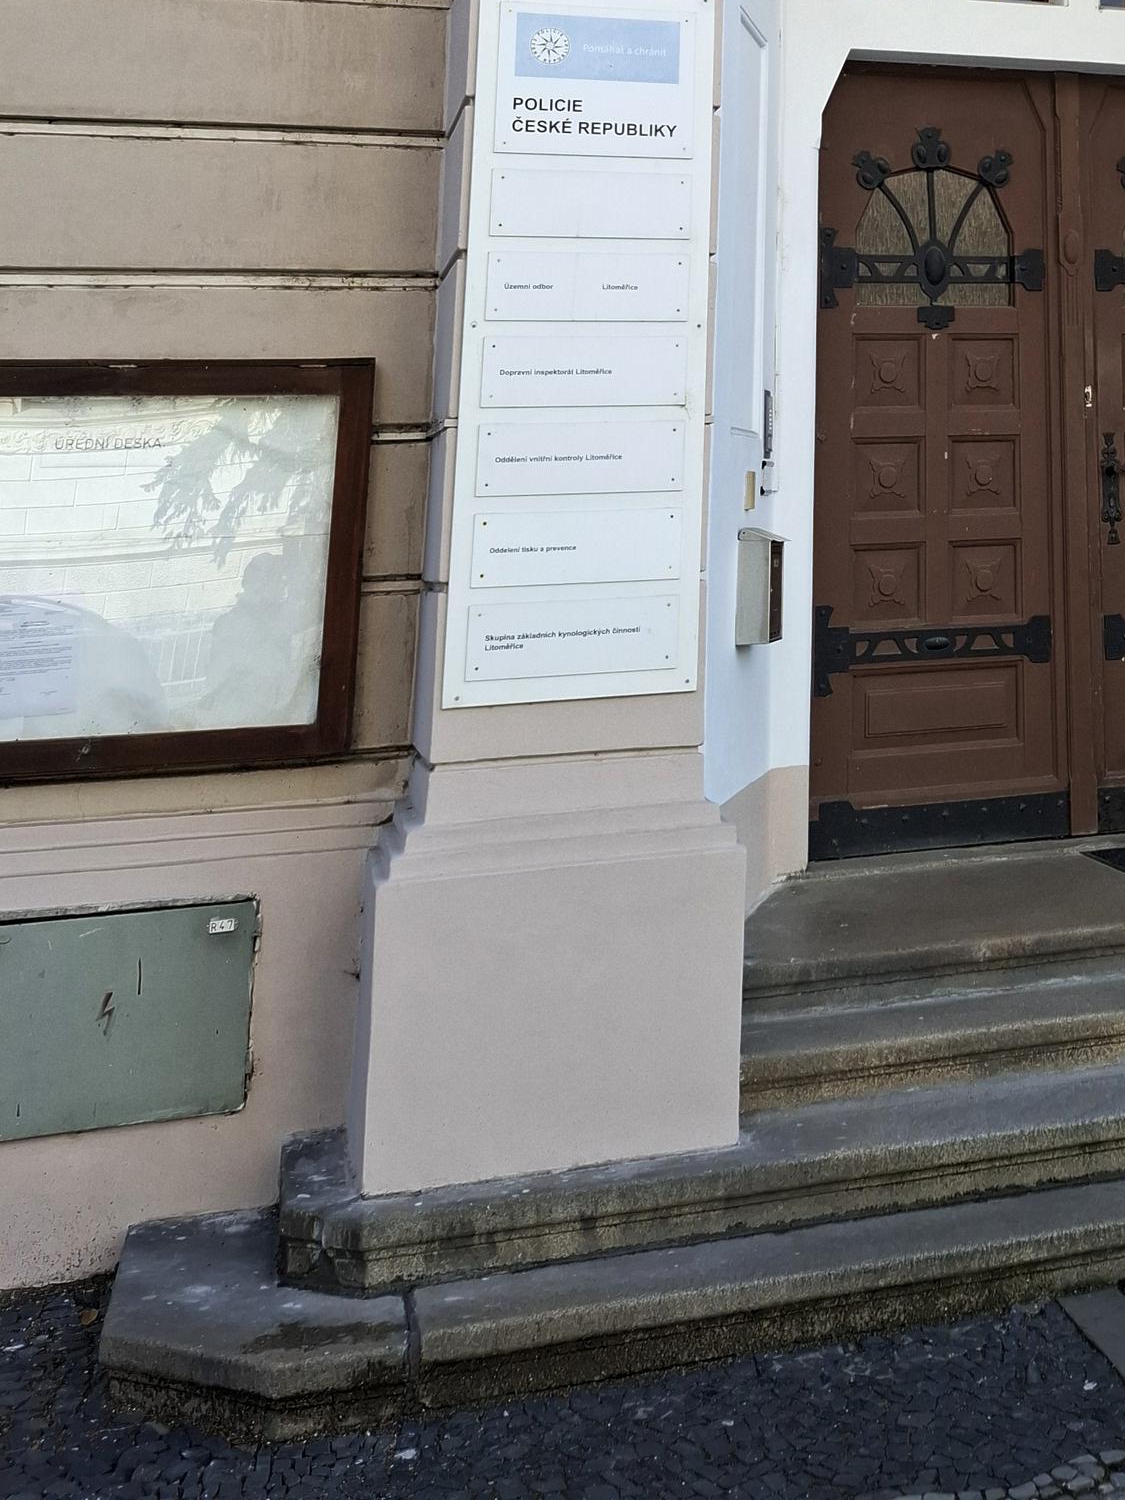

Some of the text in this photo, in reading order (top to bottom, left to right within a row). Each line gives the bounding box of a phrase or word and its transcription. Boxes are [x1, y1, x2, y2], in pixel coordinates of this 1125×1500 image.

[627, 47, 633, 55] a
[513, 97, 583, 112] POLICIE
[512, 116, 678, 138] ČESKÉ REPUBLIKY
[602, 283, 639, 291] Litoměřice
[575, 368, 612, 376] Litoměřice
[554, 454, 584, 464] kontroly
[585, 453, 623, 462] Litoměřice
[545, 545, 577, 553] prevence
[485, 634, 515, 643] Skupina
[484, 643, 524, 652] Litoměřice
